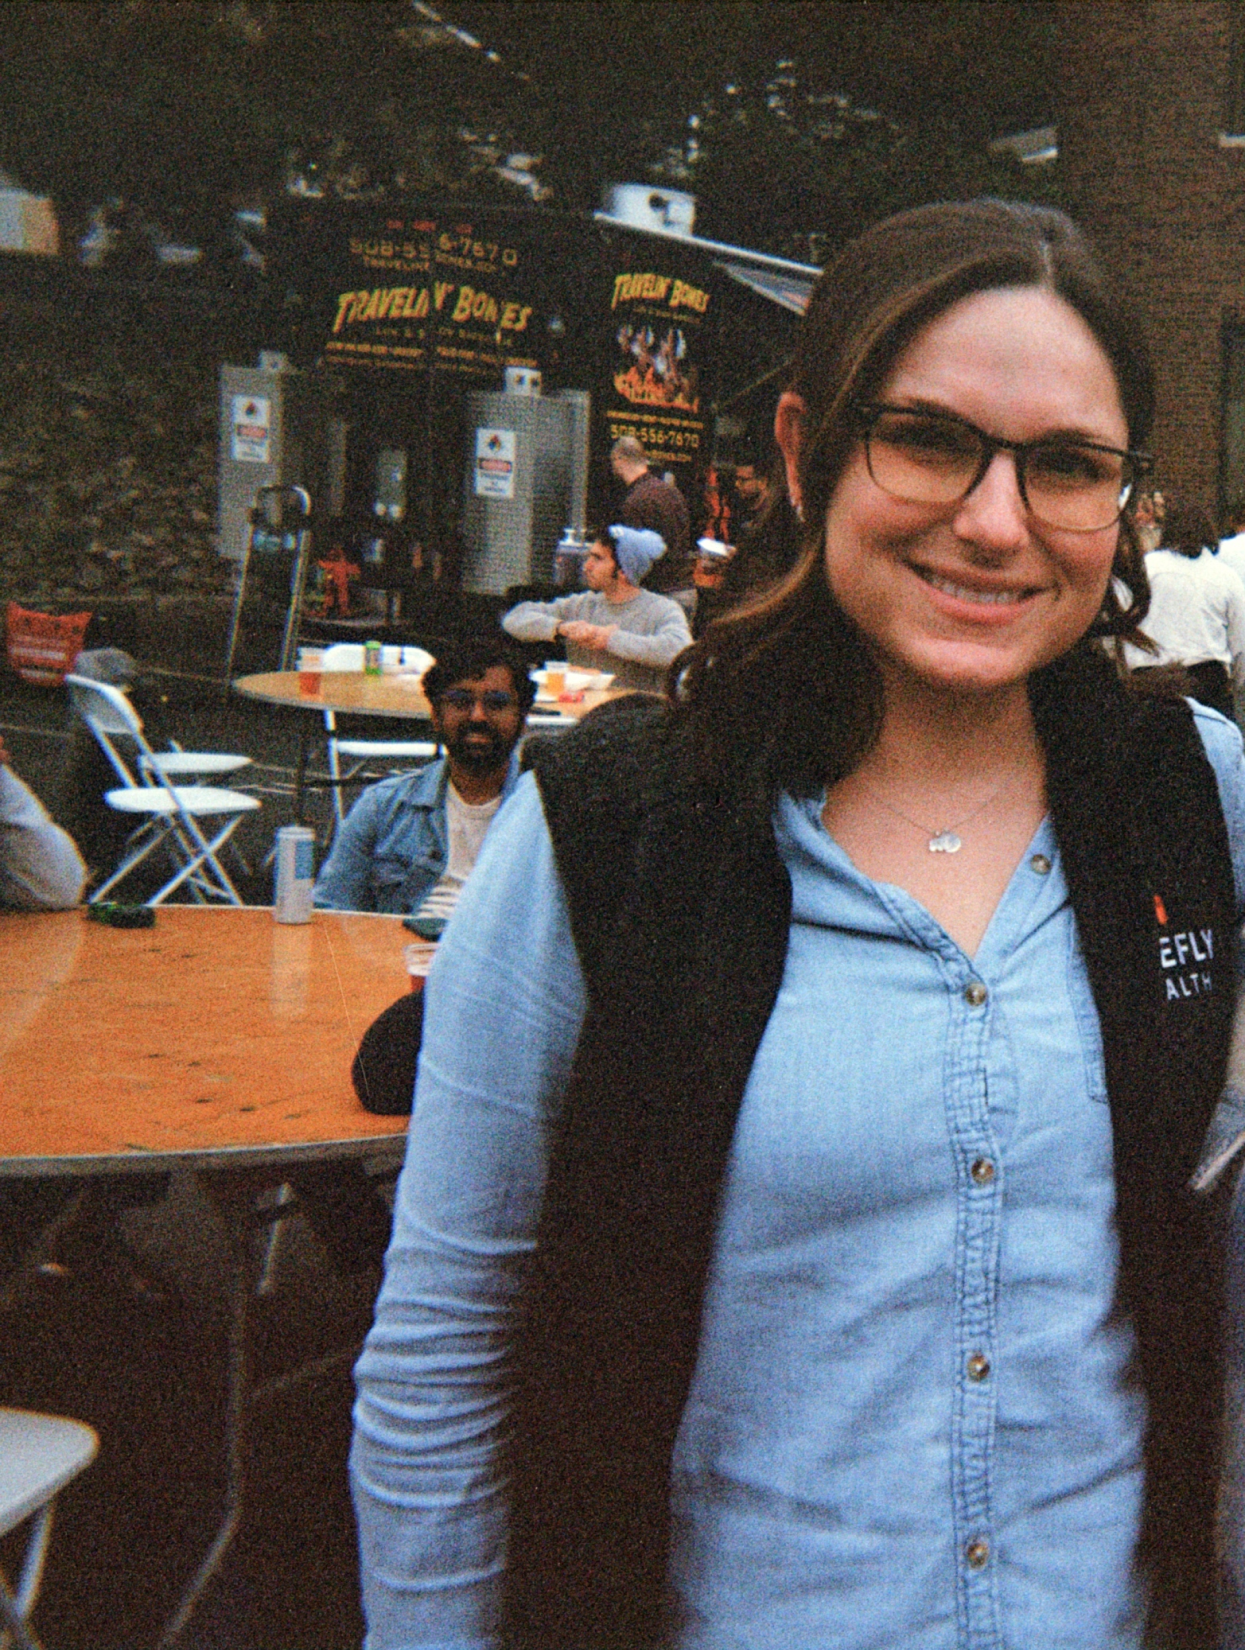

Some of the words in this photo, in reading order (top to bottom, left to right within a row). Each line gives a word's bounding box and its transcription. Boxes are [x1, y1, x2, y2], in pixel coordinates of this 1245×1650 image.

[452, 286, 532, 331] BONES
[669, 279, 710, 313] BONES
[1159, 929, 1214, 968] EFLY
[1165, 973, 1212, 1000] ALTH
